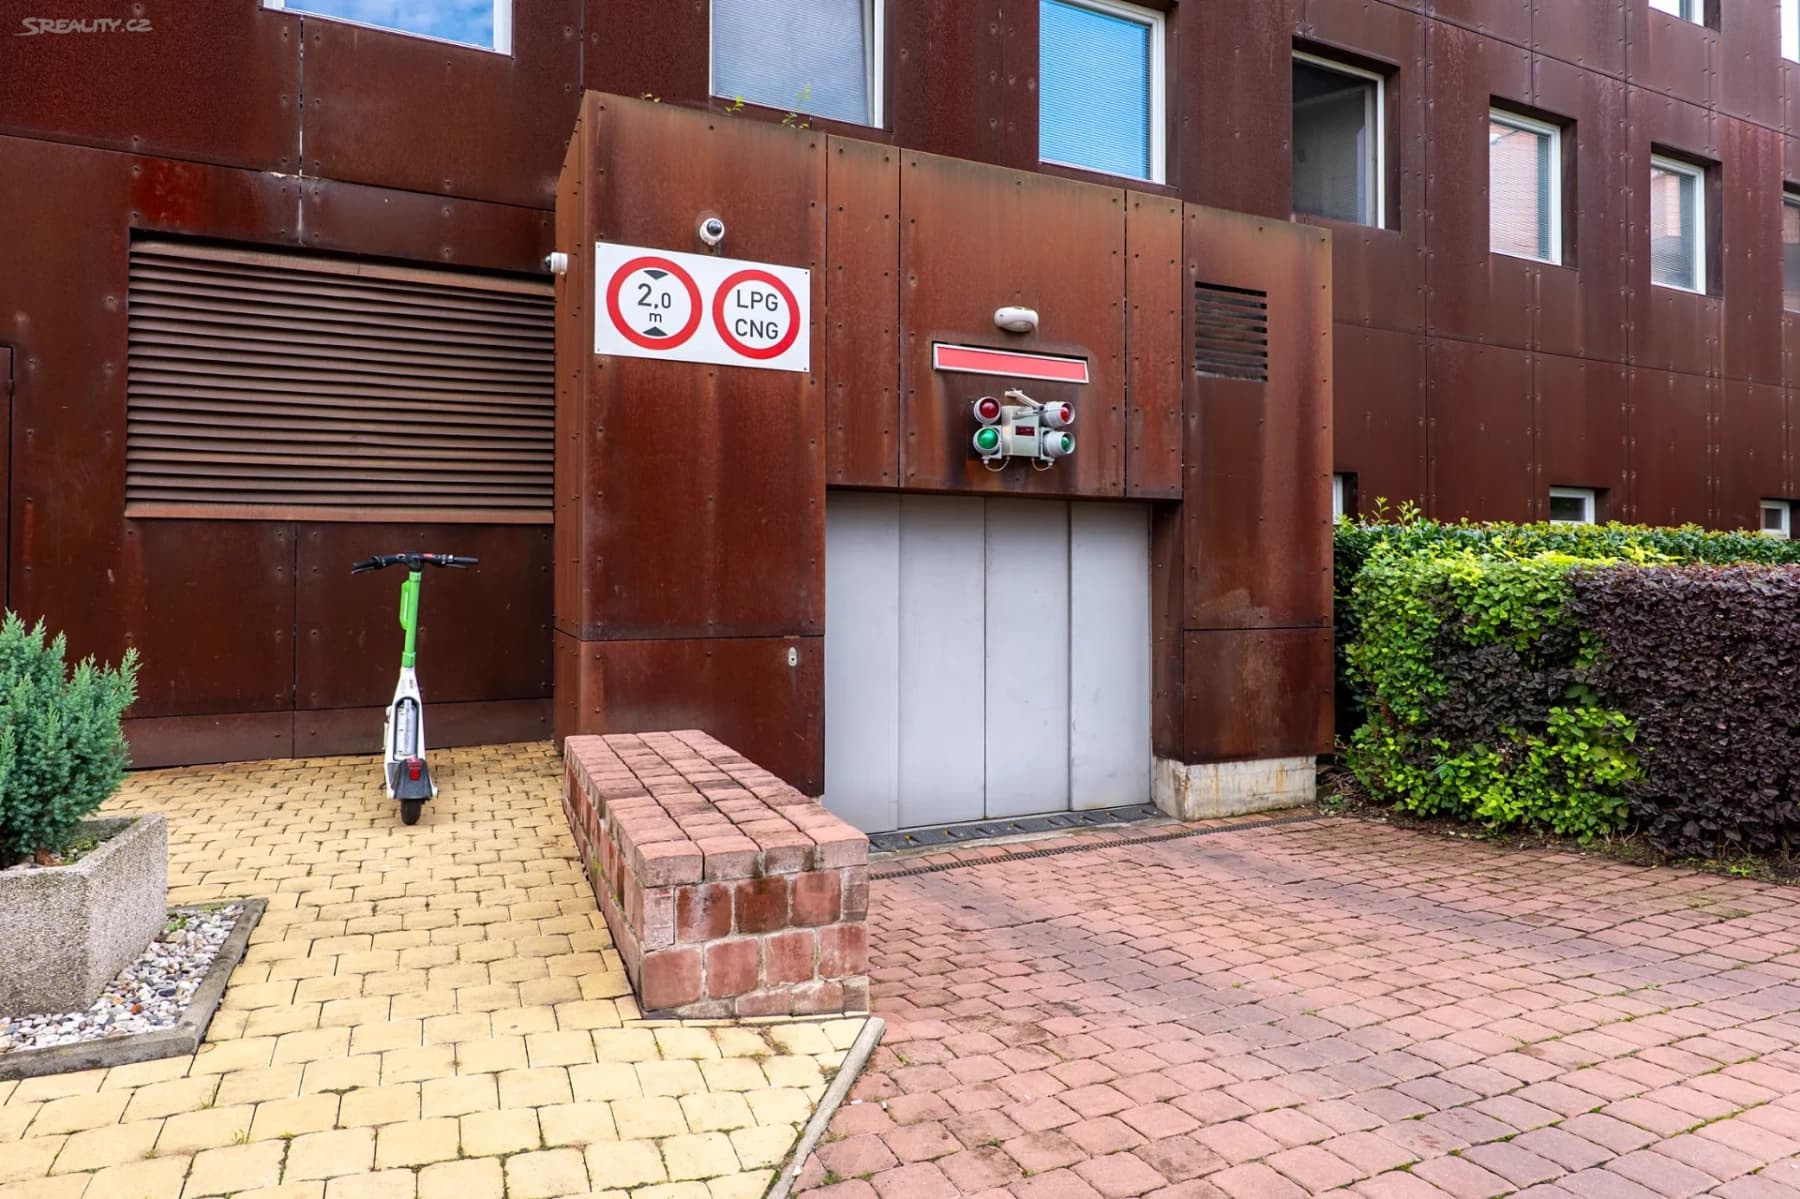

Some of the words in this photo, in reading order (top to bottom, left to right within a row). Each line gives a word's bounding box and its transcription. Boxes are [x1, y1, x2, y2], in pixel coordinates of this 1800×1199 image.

[637, 283, 671, 309] 2,0
[736, 289, 778, 311] LPG
[649, 312, 662, 323] m
[735, 318, 778, 339] CNG
